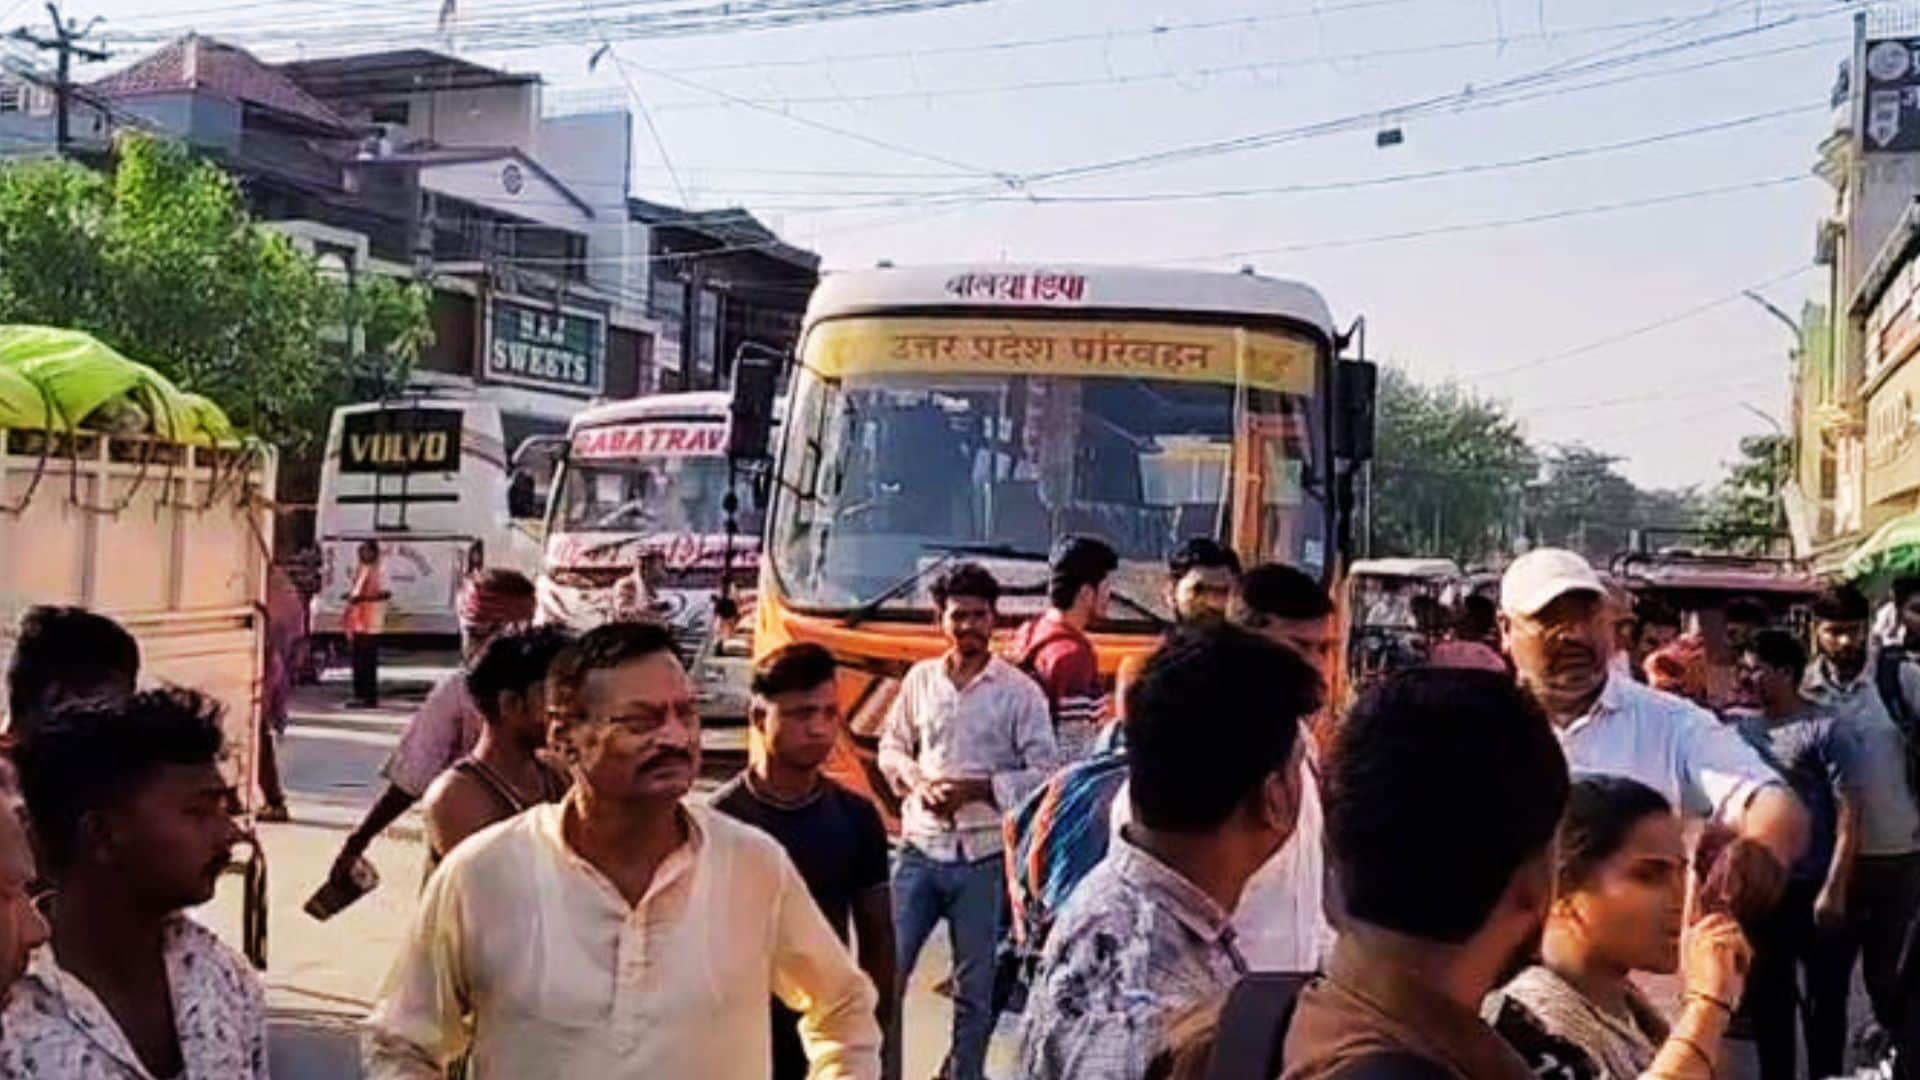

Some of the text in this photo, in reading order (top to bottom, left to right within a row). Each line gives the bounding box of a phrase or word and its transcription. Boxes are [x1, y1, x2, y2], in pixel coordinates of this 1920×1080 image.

[493, 338, 588, 382] SWEETS
[891, 334, 958, 361] उत्तर
[971, 326, 1057, 366] प्रदेश
[1071, 329, 1215, 370] परिवहन
